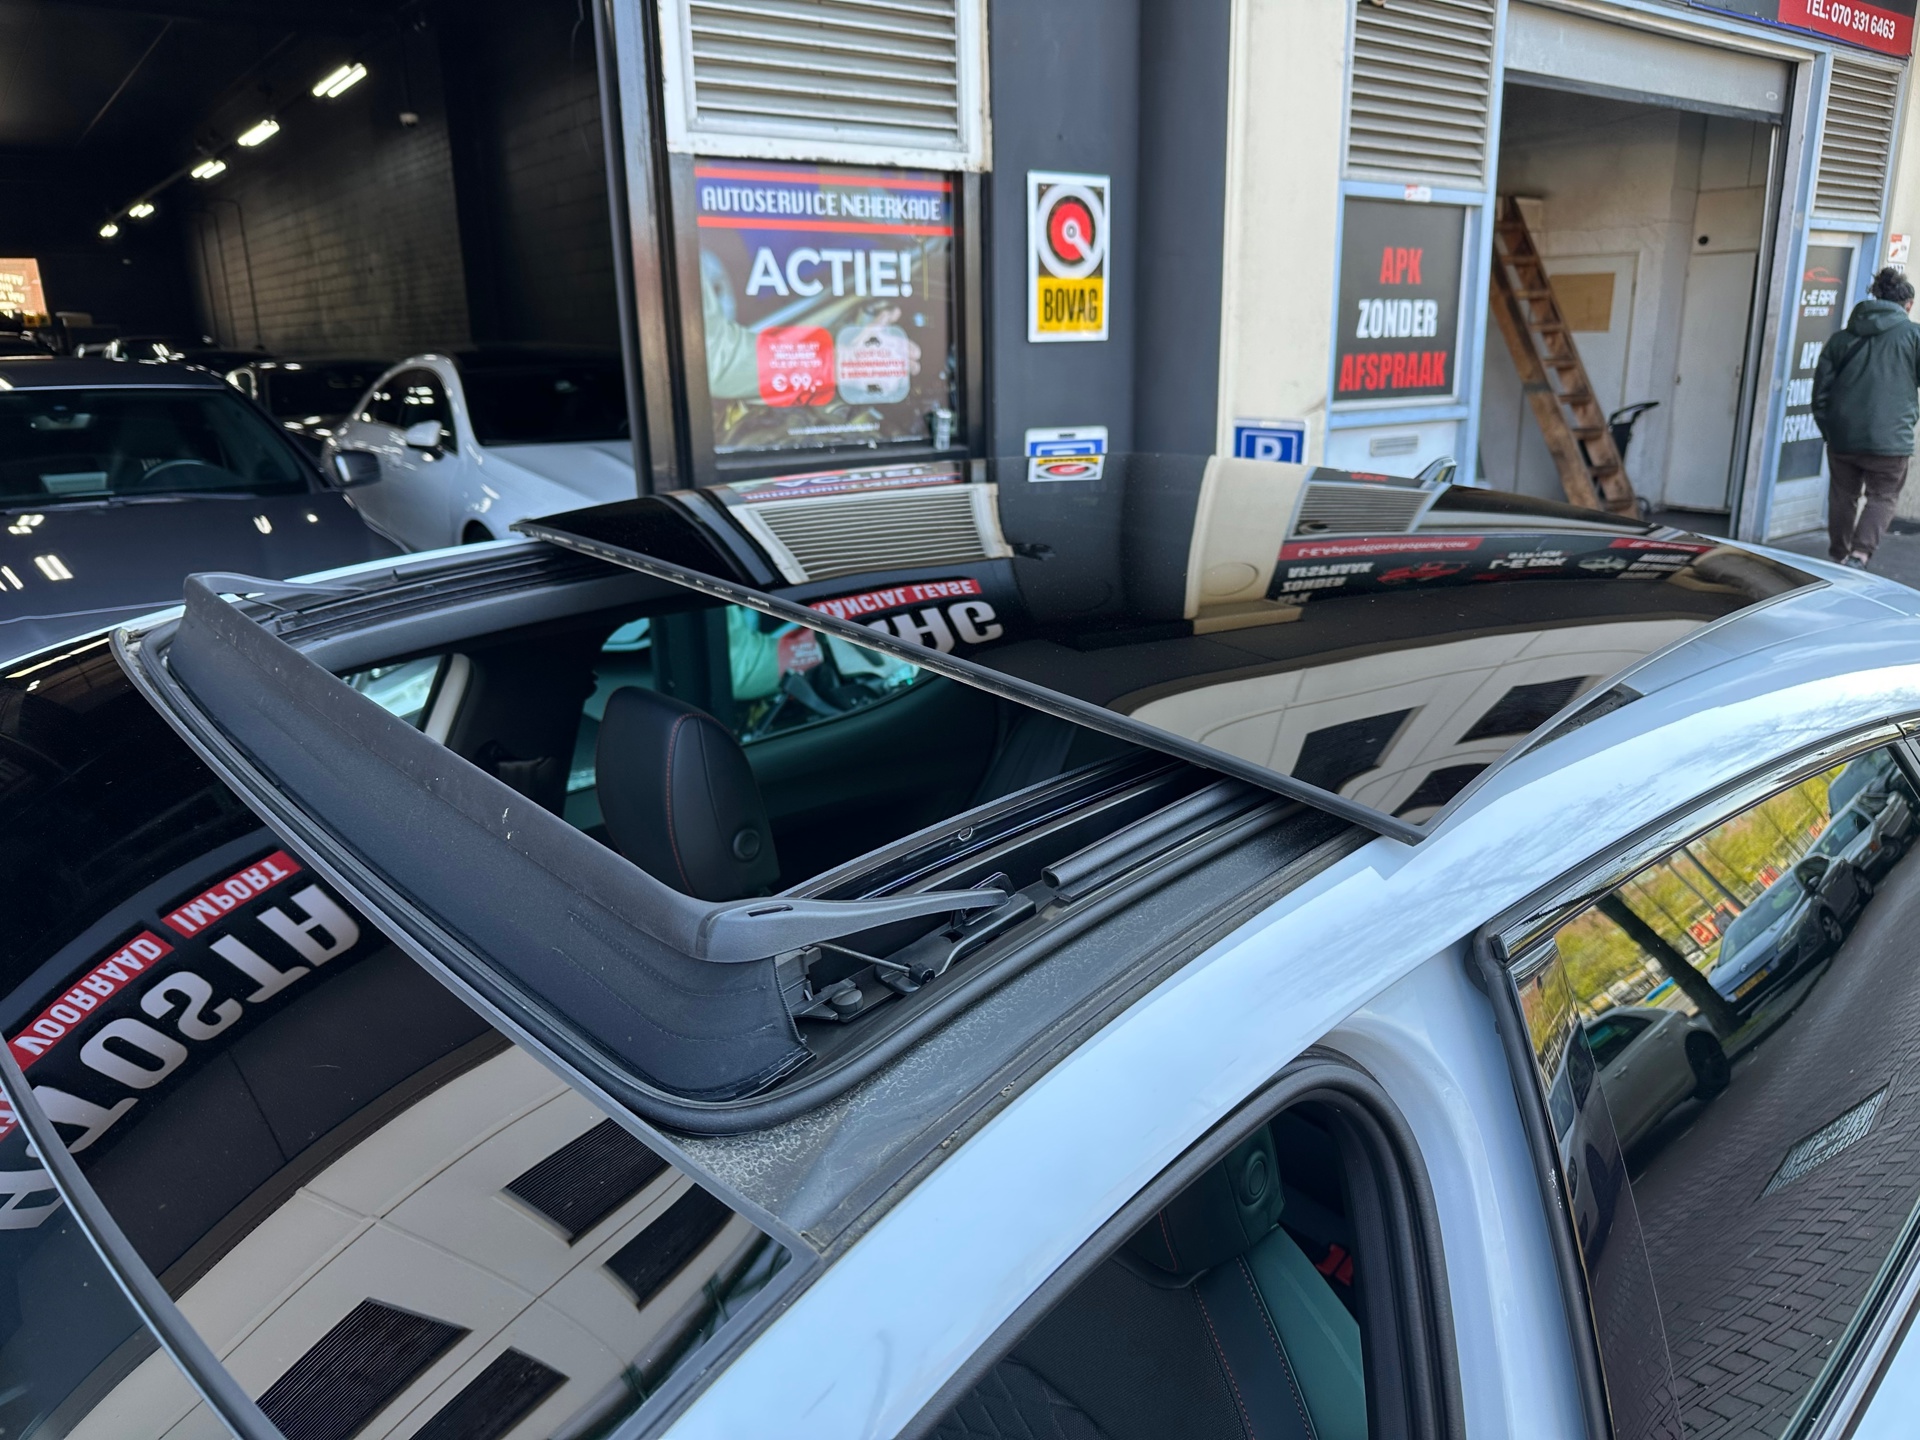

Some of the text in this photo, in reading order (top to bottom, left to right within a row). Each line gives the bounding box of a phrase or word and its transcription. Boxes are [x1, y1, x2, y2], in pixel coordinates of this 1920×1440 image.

[1806, 0, 1895, 40] TEL: 070 331 6463
[701, 186, 942, 221] AUTOSERVICE NEHERKADE
[745, 246, 914, 298] ACTIE!
[1379, 247, 1423, 285] APK
[1044, 288, 1098, 323] BOVAG
[1356, 298, 1438, 339] ZONDER
[771, 373, 788, 393] €
[1339, 352, 1447, 391] AFSPRAAK
